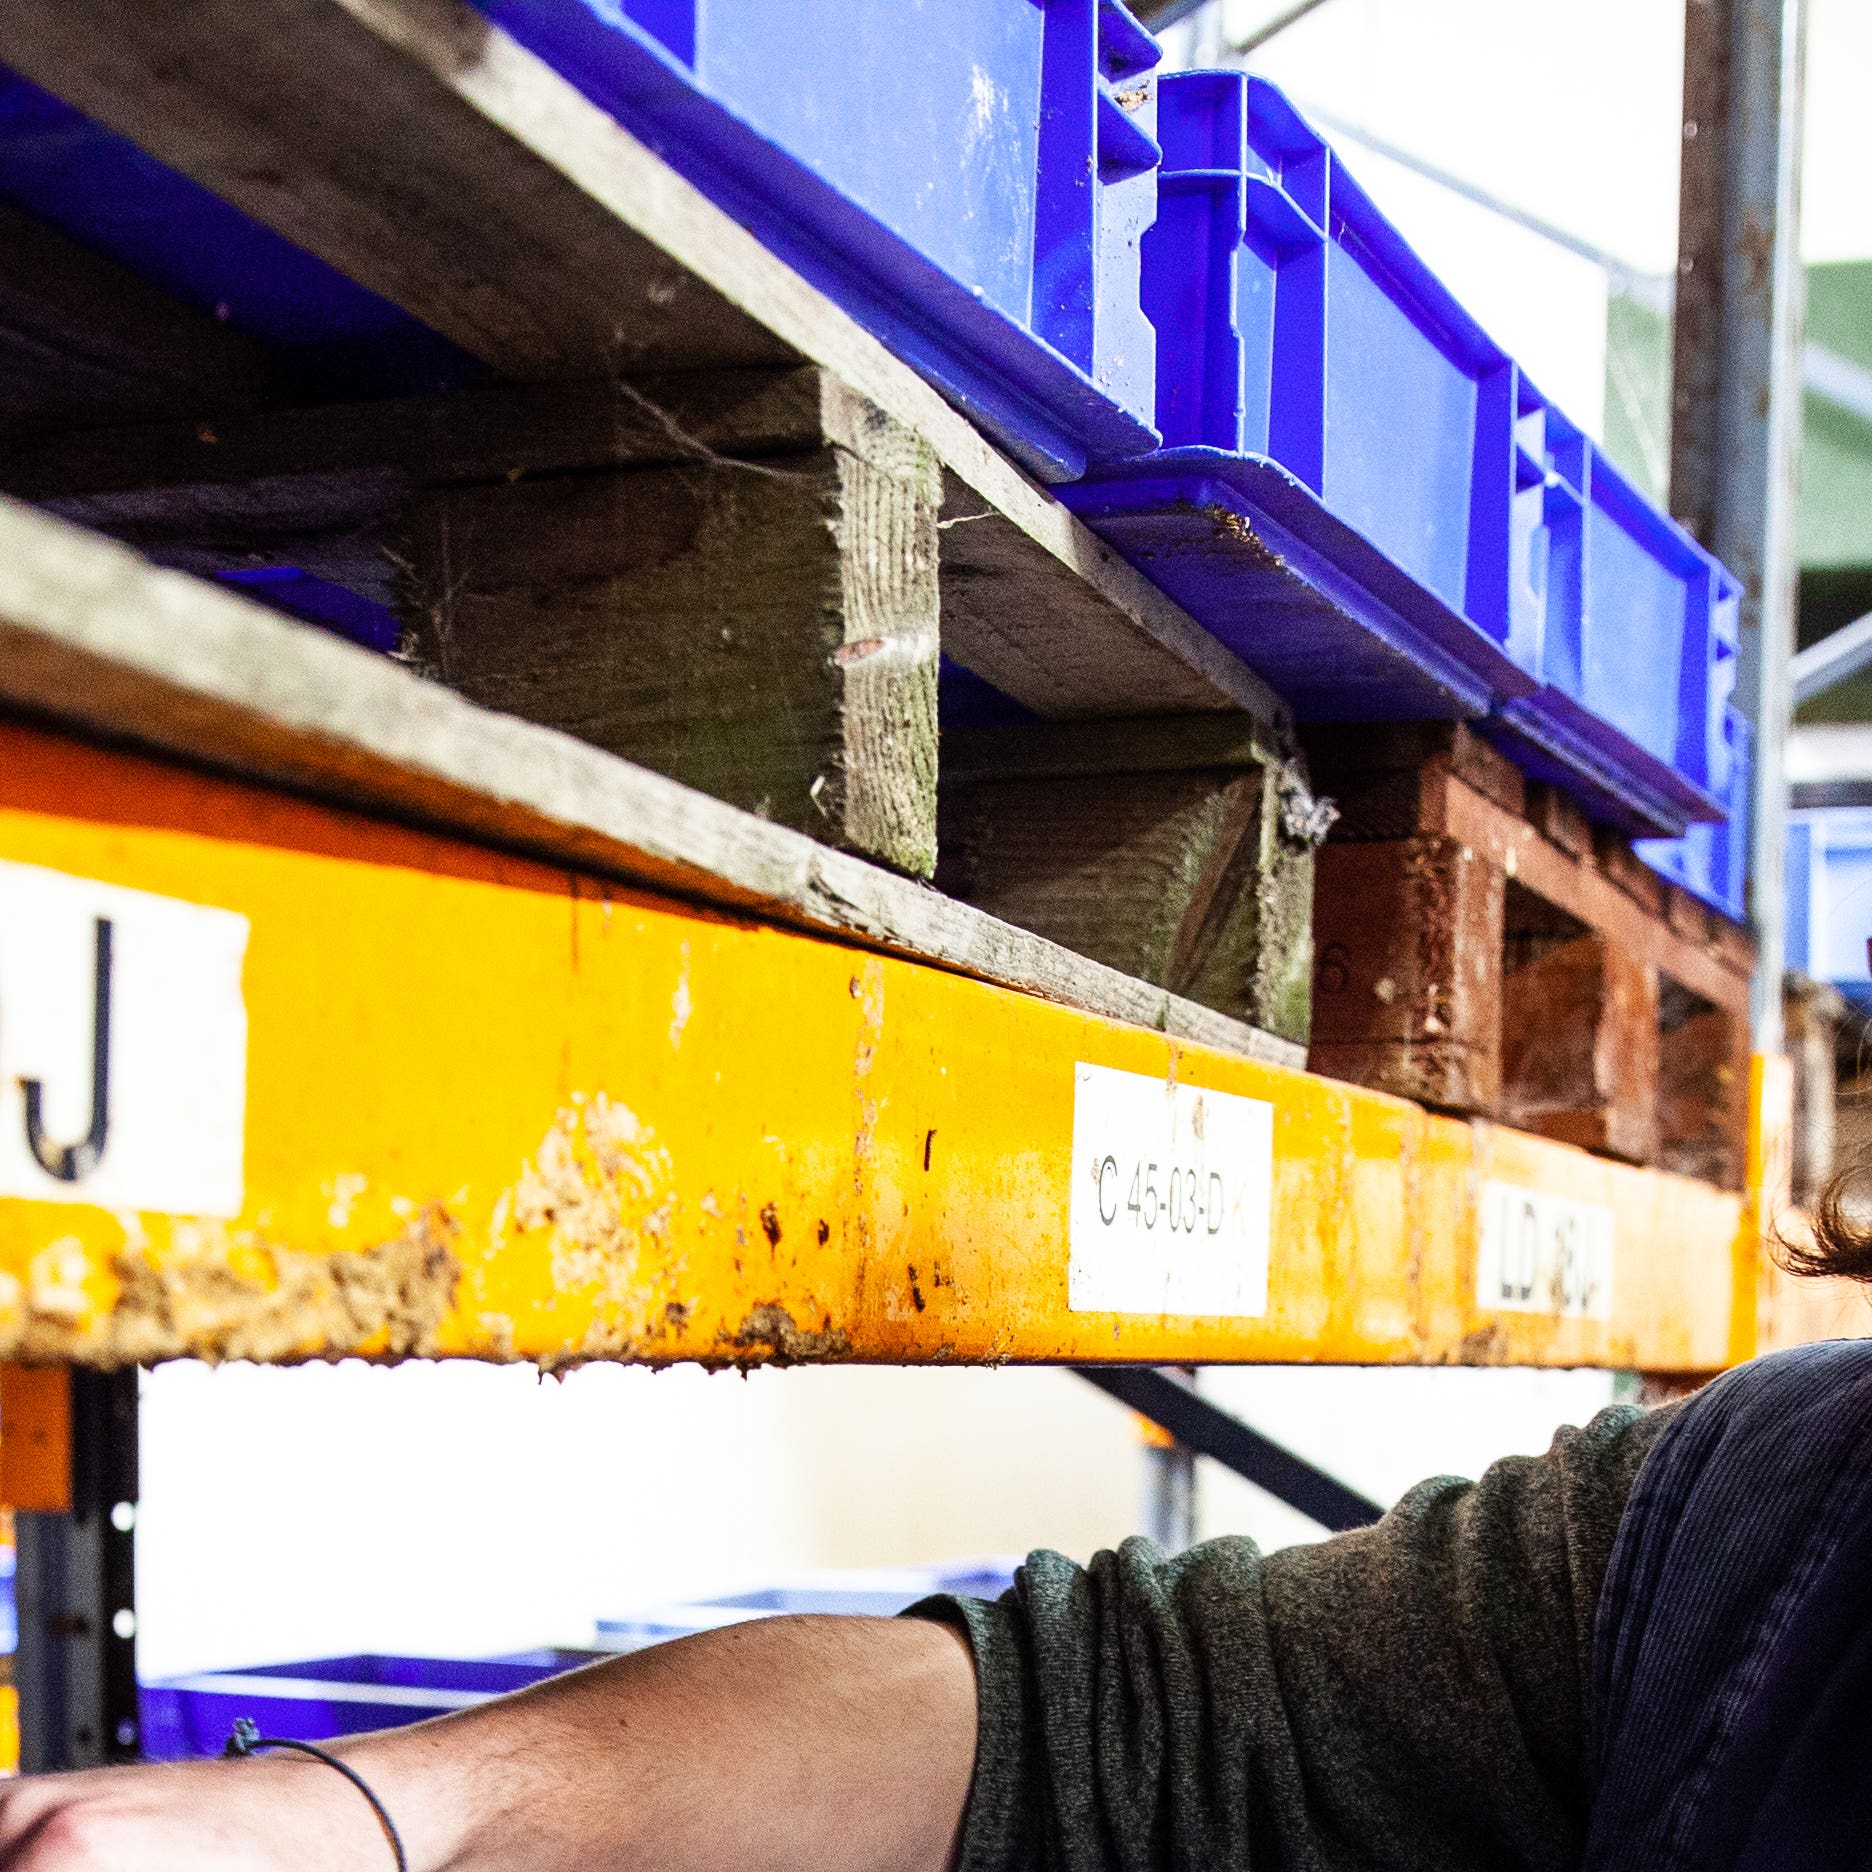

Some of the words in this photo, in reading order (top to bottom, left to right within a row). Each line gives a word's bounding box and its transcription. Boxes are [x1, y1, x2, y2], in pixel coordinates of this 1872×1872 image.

[1098, 1154, 1119, 1227] C
[1126, 1160, 1226, 1236] 45-03-D
[1499, 1194, 1540, 1302] LD
